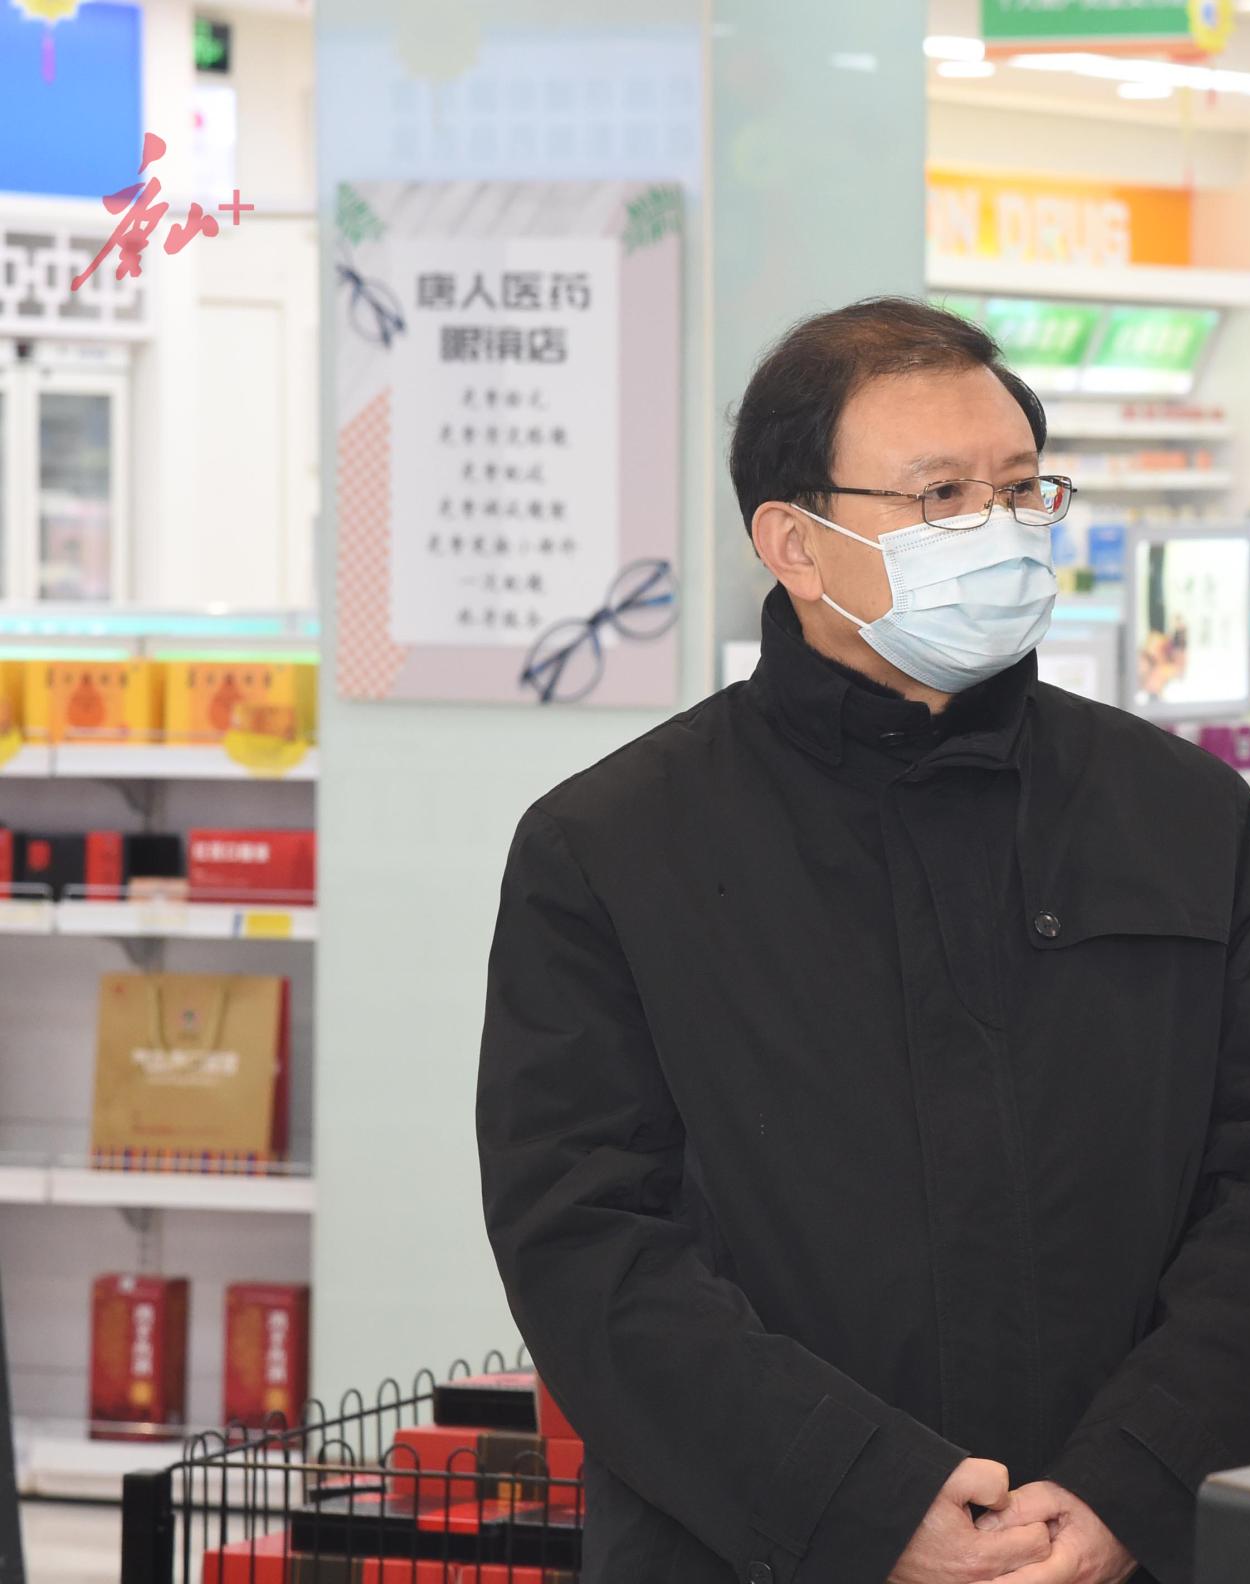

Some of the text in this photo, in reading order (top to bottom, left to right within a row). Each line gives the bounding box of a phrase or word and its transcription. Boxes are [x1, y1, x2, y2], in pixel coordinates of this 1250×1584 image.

[998, 191, 1128, 265] DRUG
[416, 271, 592, 311] 唐人医药
